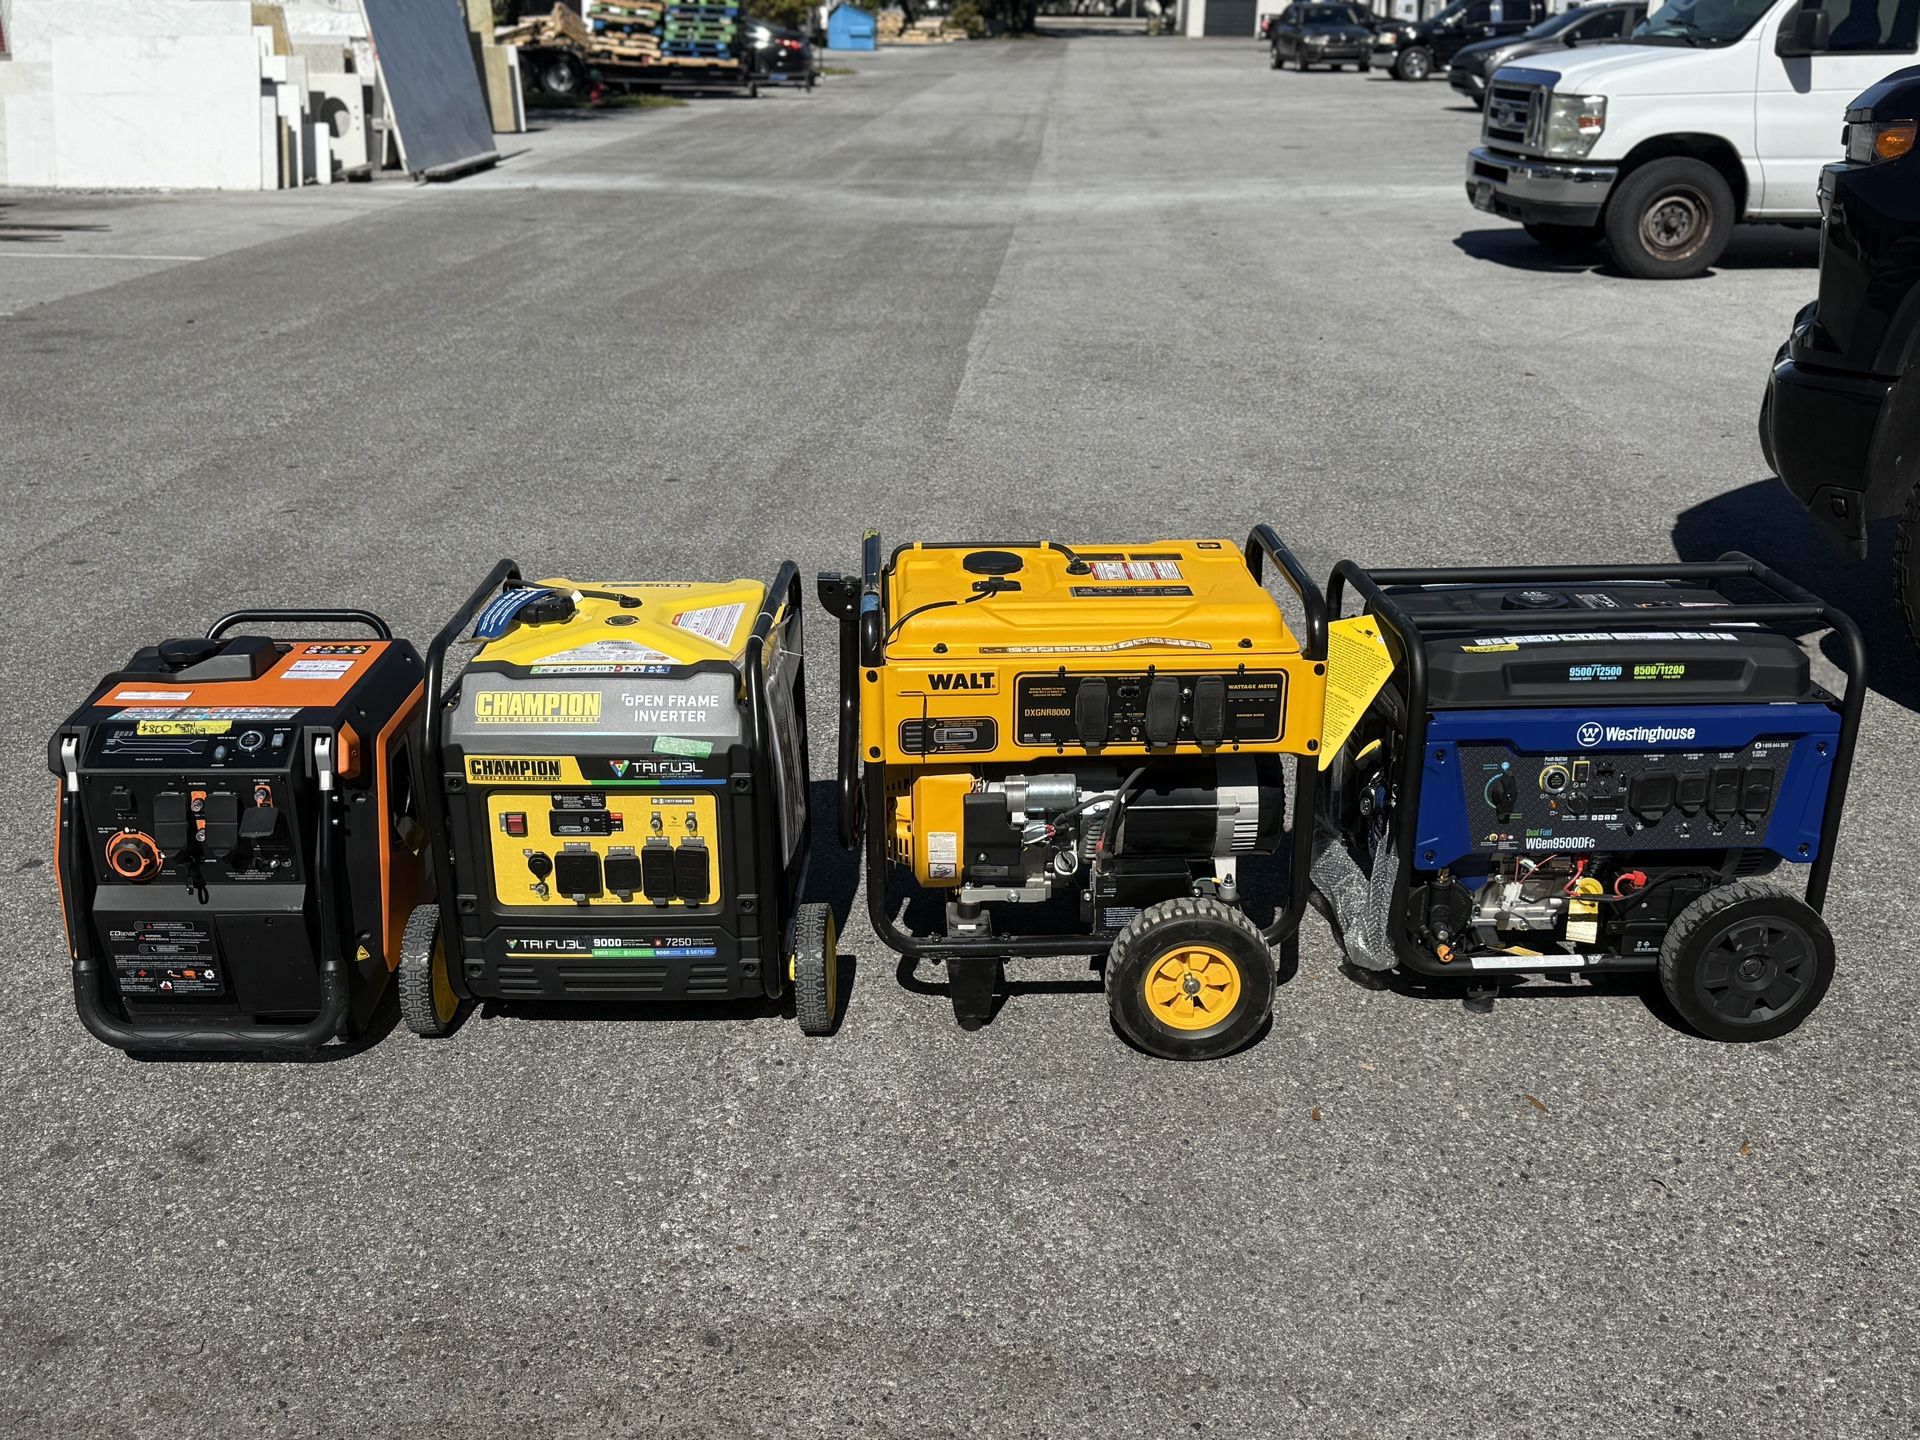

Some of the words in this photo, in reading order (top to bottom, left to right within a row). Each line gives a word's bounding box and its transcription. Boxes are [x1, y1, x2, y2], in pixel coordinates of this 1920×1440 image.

[1569, 667, 1622, 676] 9500/12500
[1634, 665, 1685, 675] 8500/11200
[478, 692, 600, 716] CHAMPION
[622, 694, 663, 707] OPEN
[668, 695, 719, 707] FRAME
[634, 710, 706, 722] INVERTER
[1024, 708, 1070, 717] DXGNR8000
[1606, 726, 1696, 744] Westinghouse
[471, 760, 560, 776] CHAMPION
[632, 763, 659, 772] TRI
[1526, 829, 1539, 837] Dual
[1540, 828, 1552, 836] Fuel
[1526, 837, 1595, 849] WGen9500DFc
[520, 939, 544, 949] TRI
[593, 938, 622, 947] 9000
[666, 938, 692, 946] 7250
